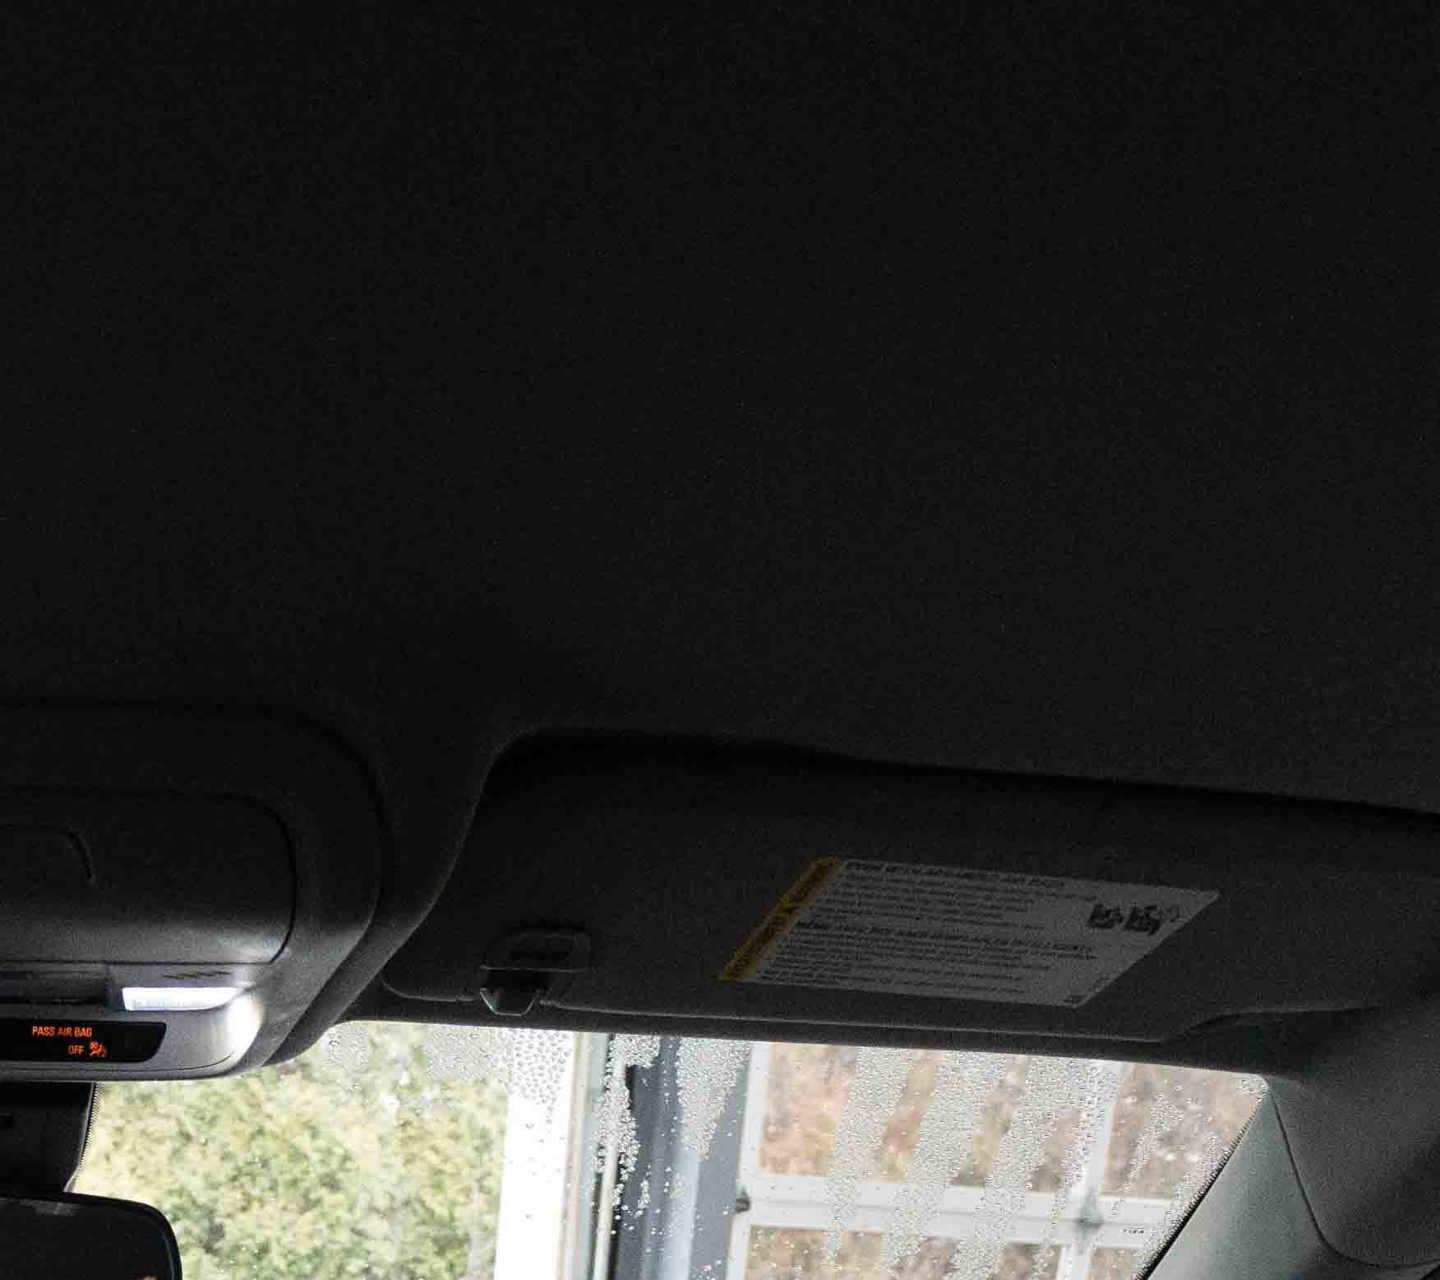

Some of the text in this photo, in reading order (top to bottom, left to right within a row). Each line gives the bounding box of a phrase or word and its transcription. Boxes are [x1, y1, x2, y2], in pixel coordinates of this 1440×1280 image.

[32, 1025, 93, 1038] PASS AIR BAG
[68, 1044, 85, 1056] OFF
